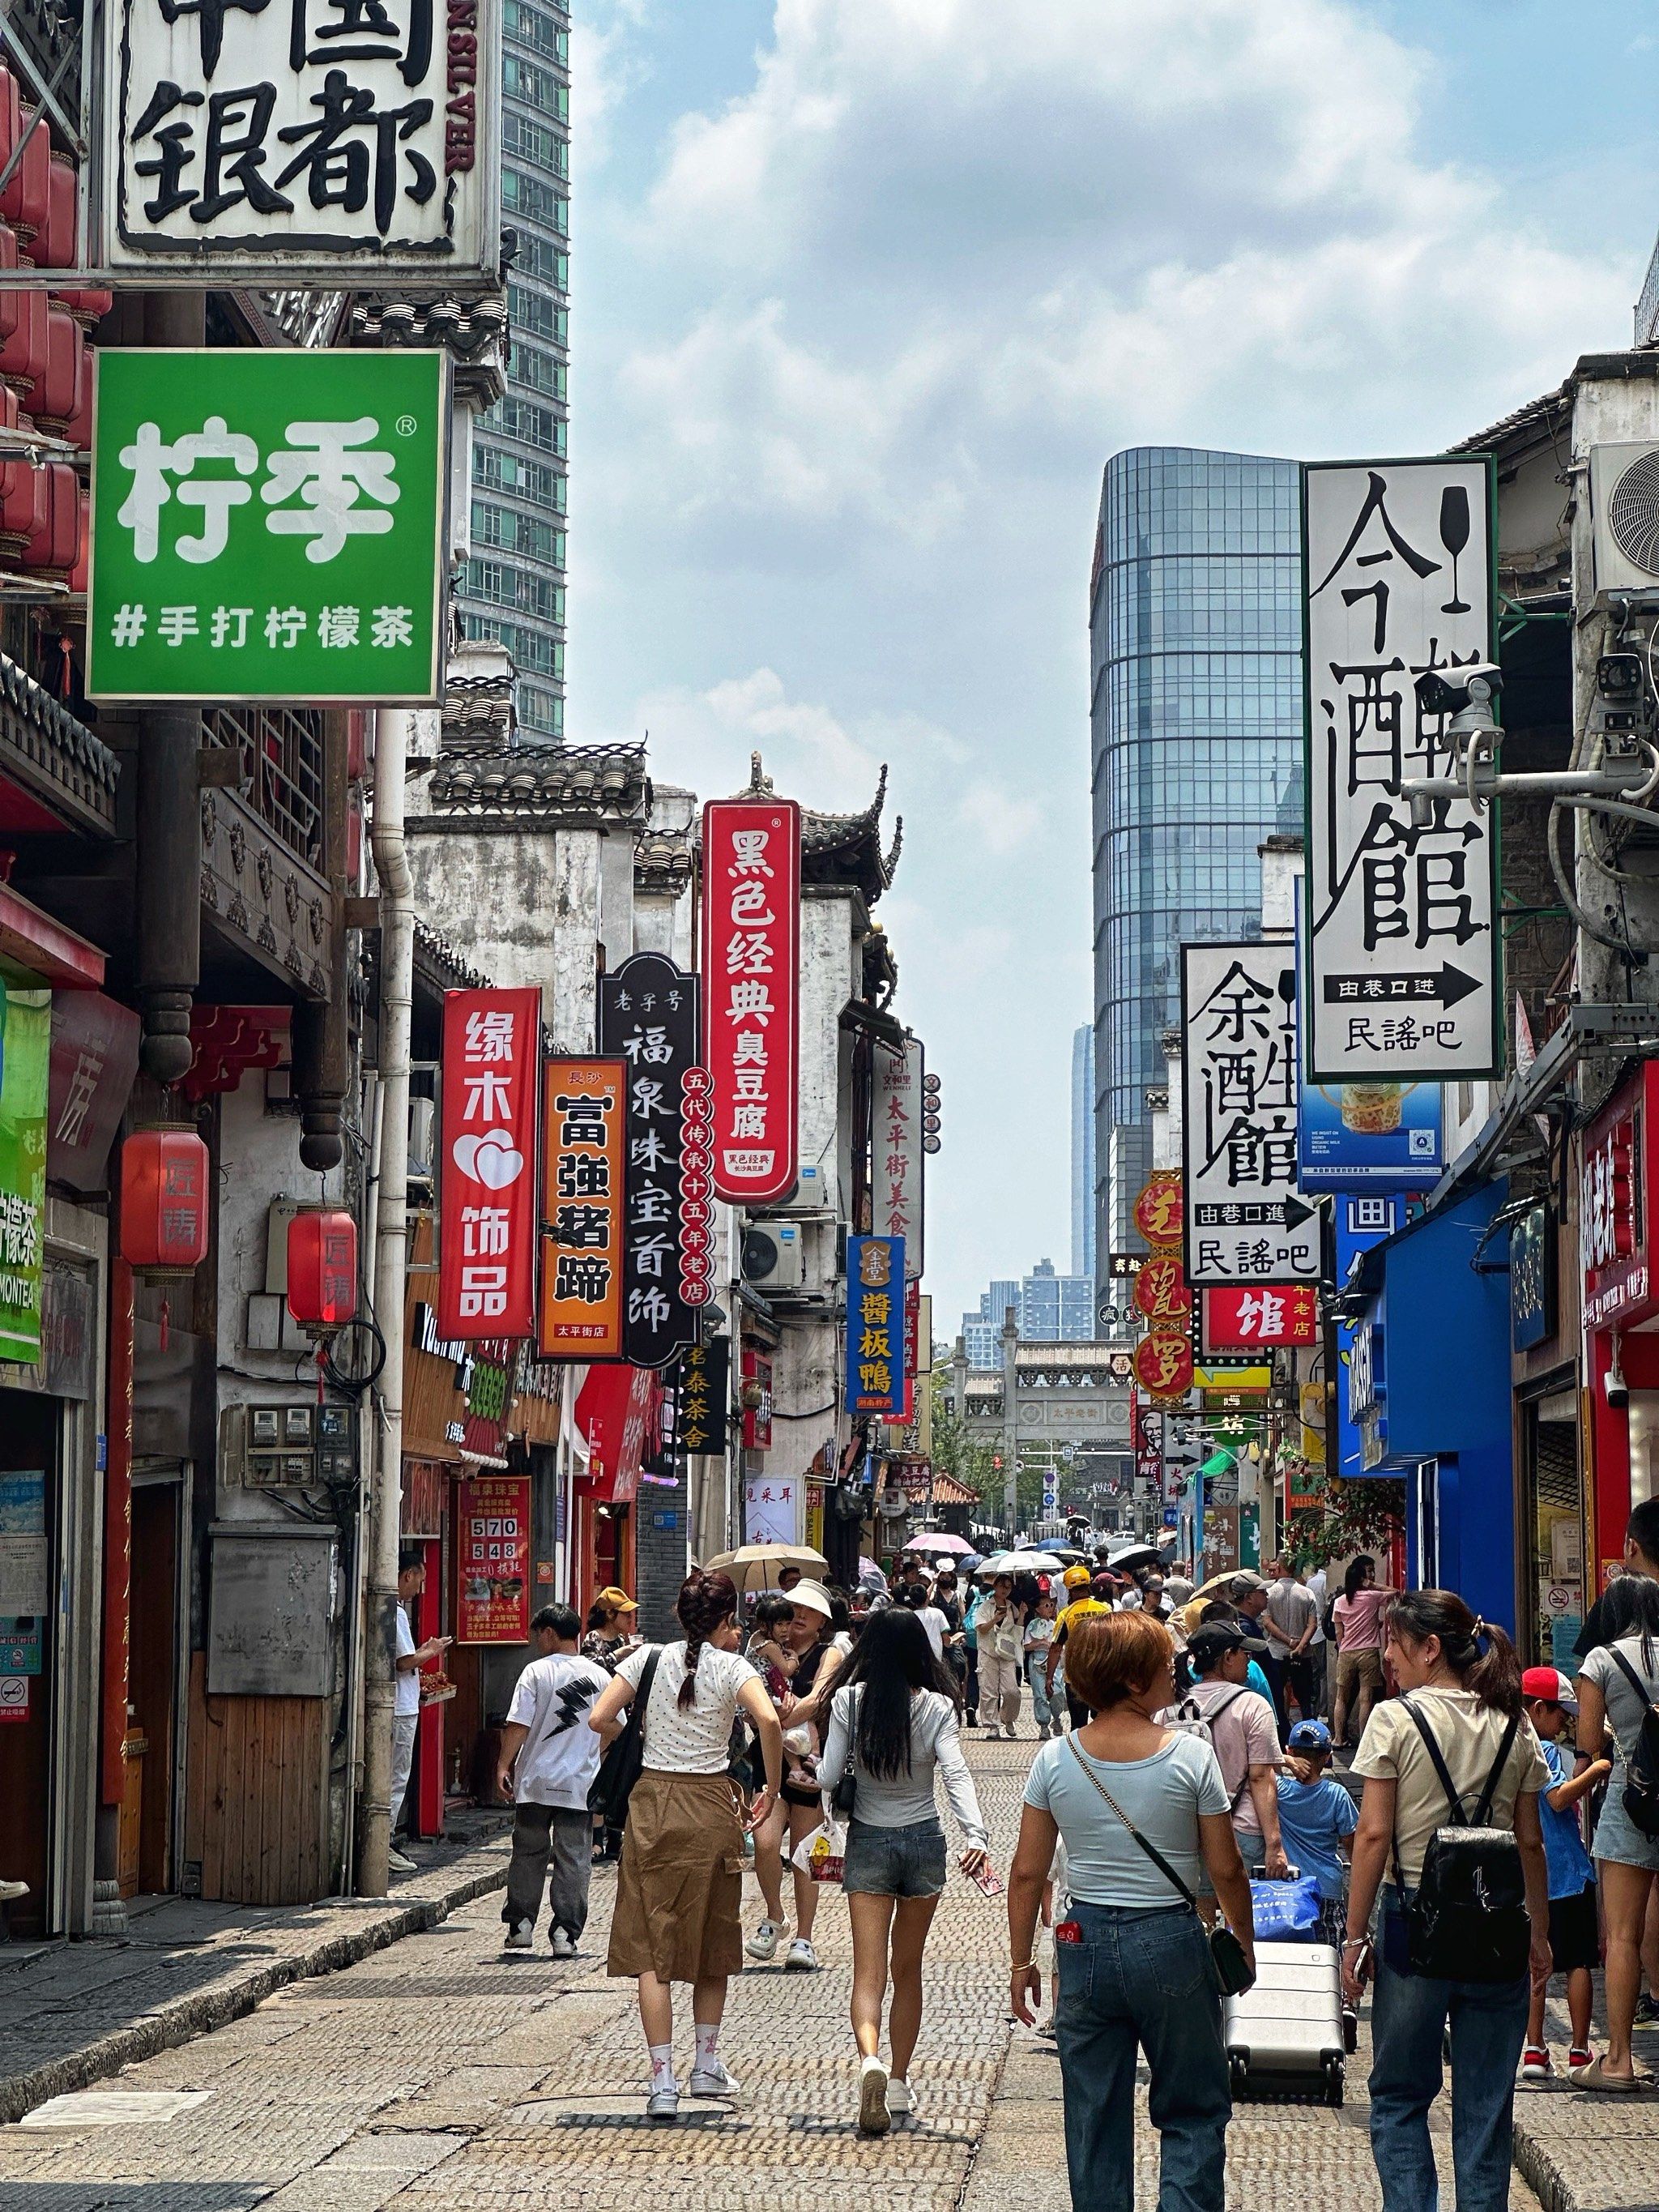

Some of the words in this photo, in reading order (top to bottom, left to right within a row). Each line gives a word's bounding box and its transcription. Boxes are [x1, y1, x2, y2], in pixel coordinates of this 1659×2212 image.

[130, 70, 437, 235] 银都
[118, 416, 401, 565] 柠季
[111, 604, 415, 649] #手打柠檬茶
[725, 830, 775, 1141] 黑色经典臭豆腐
[1339, 979, 1436, 997] 由巷口进
[883, 1074, 911, 1085] 文和里
[729, 1154, 770, 1165] 黑色经典
[622, 1023, 679, 1335] 福泉珠宝首饰
[684, 1071, 708, 1303] 五代传承十五年老店
[885, 1095, 912, 1265] 太平街美食
[1115, 1258, 1150, 1273] 奔赴
[1236, 1291, 1286, 1337] 馆
[558, 1326, 605, 1338] 太平街店
[900, 1464, 931, 1476] 臭豆腐
[469, 1484, 519, 1496] 福泉珠宝
[473, 1521, 515, 1535] 570
[475, 1544, 514, 1557] 548
